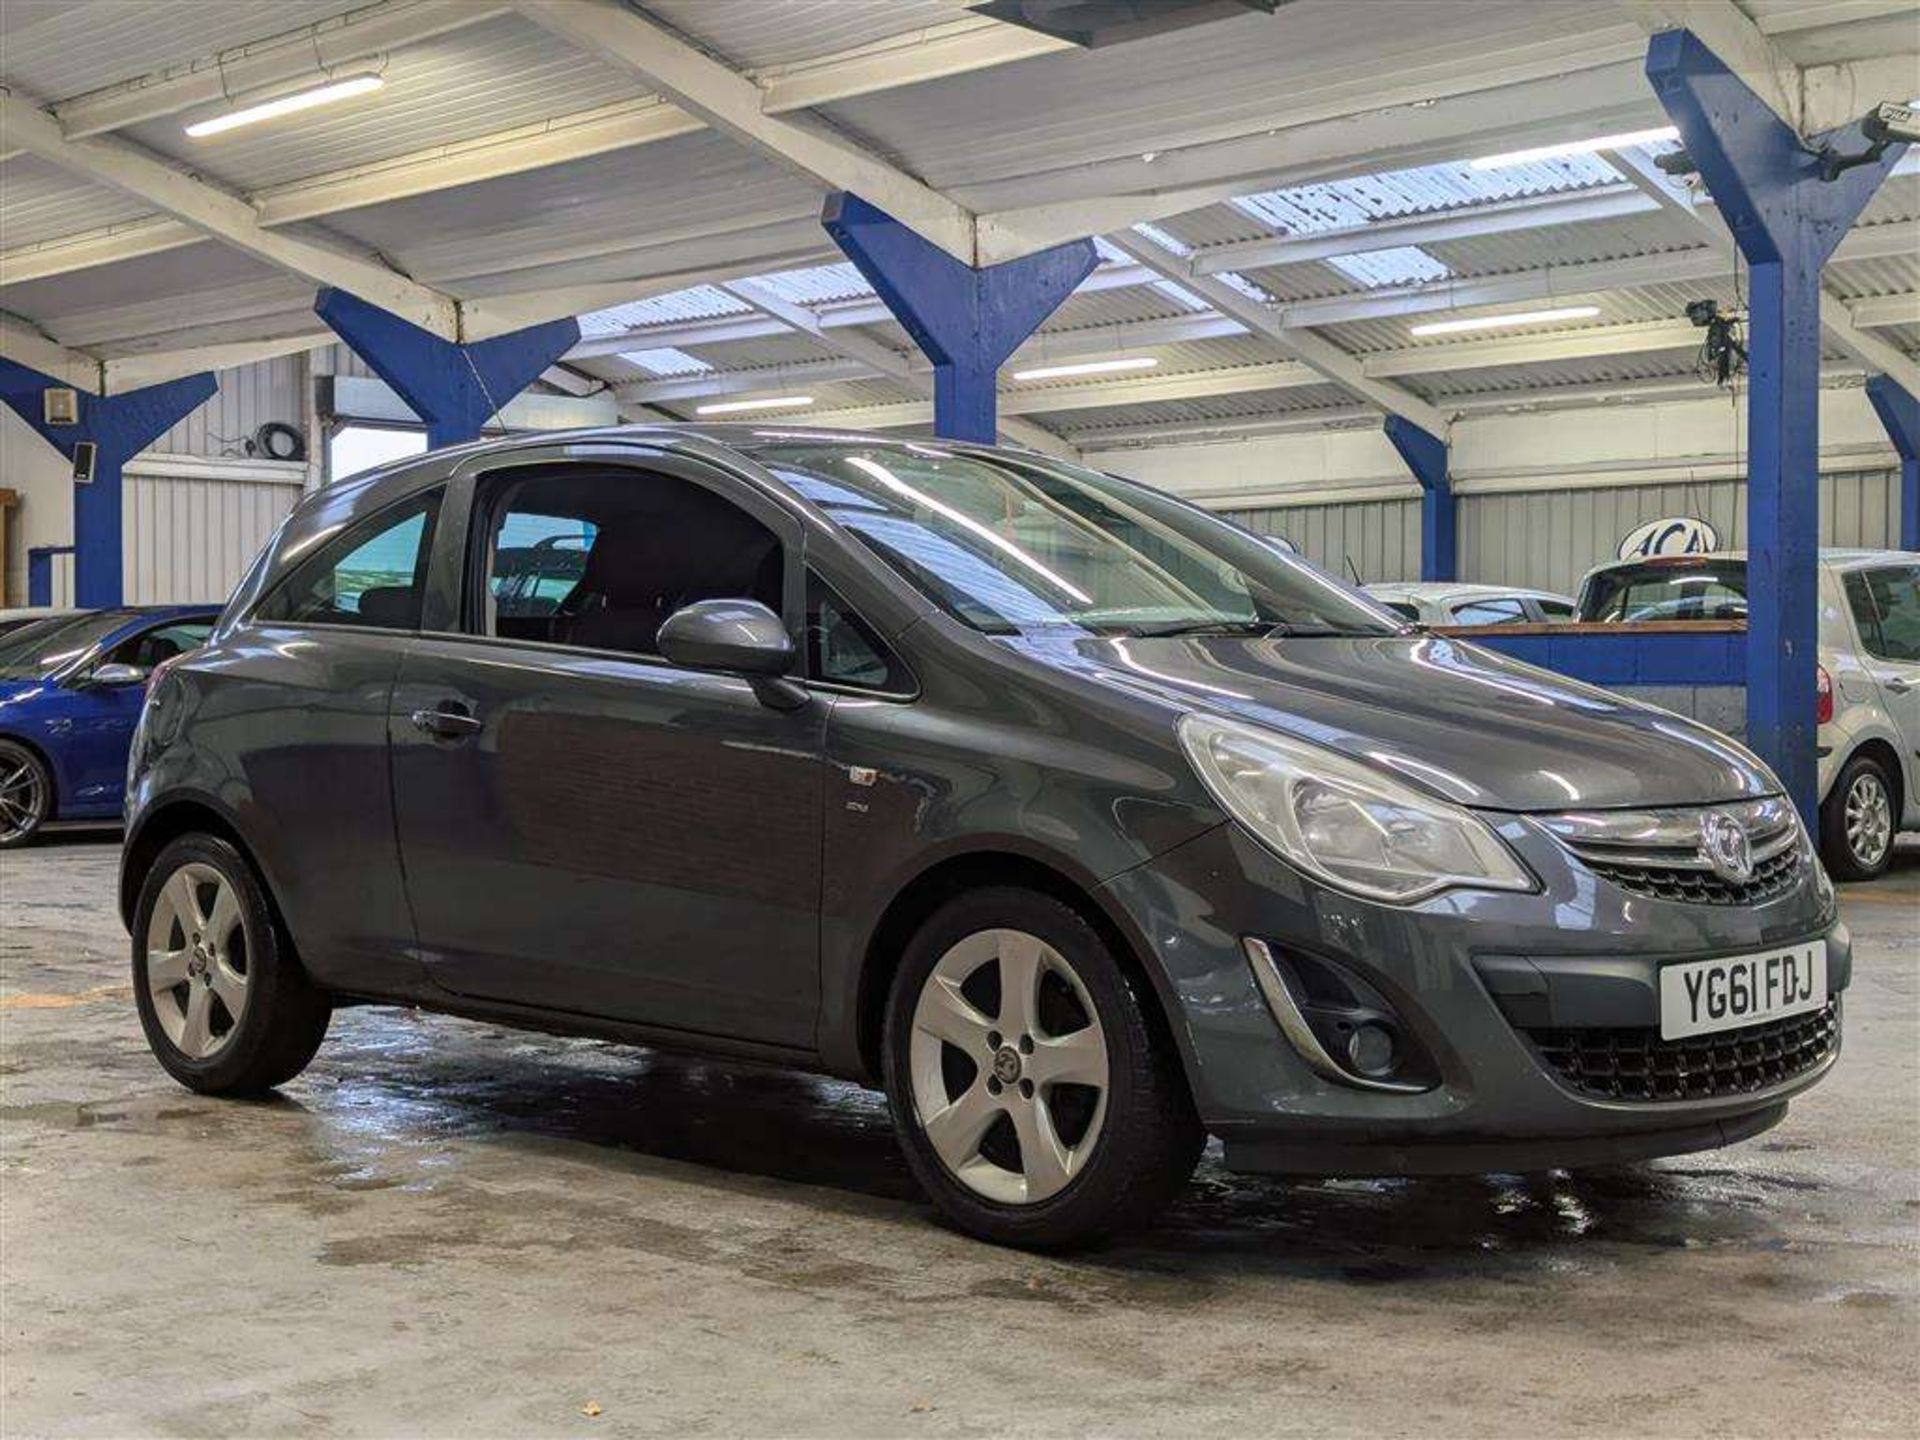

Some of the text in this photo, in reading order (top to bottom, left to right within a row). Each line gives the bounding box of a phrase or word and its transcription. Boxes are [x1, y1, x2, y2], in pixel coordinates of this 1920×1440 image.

[1624, 523, 1711, 560] ACA
[1684, 950, 1812, 1023] YG61 FDJ
